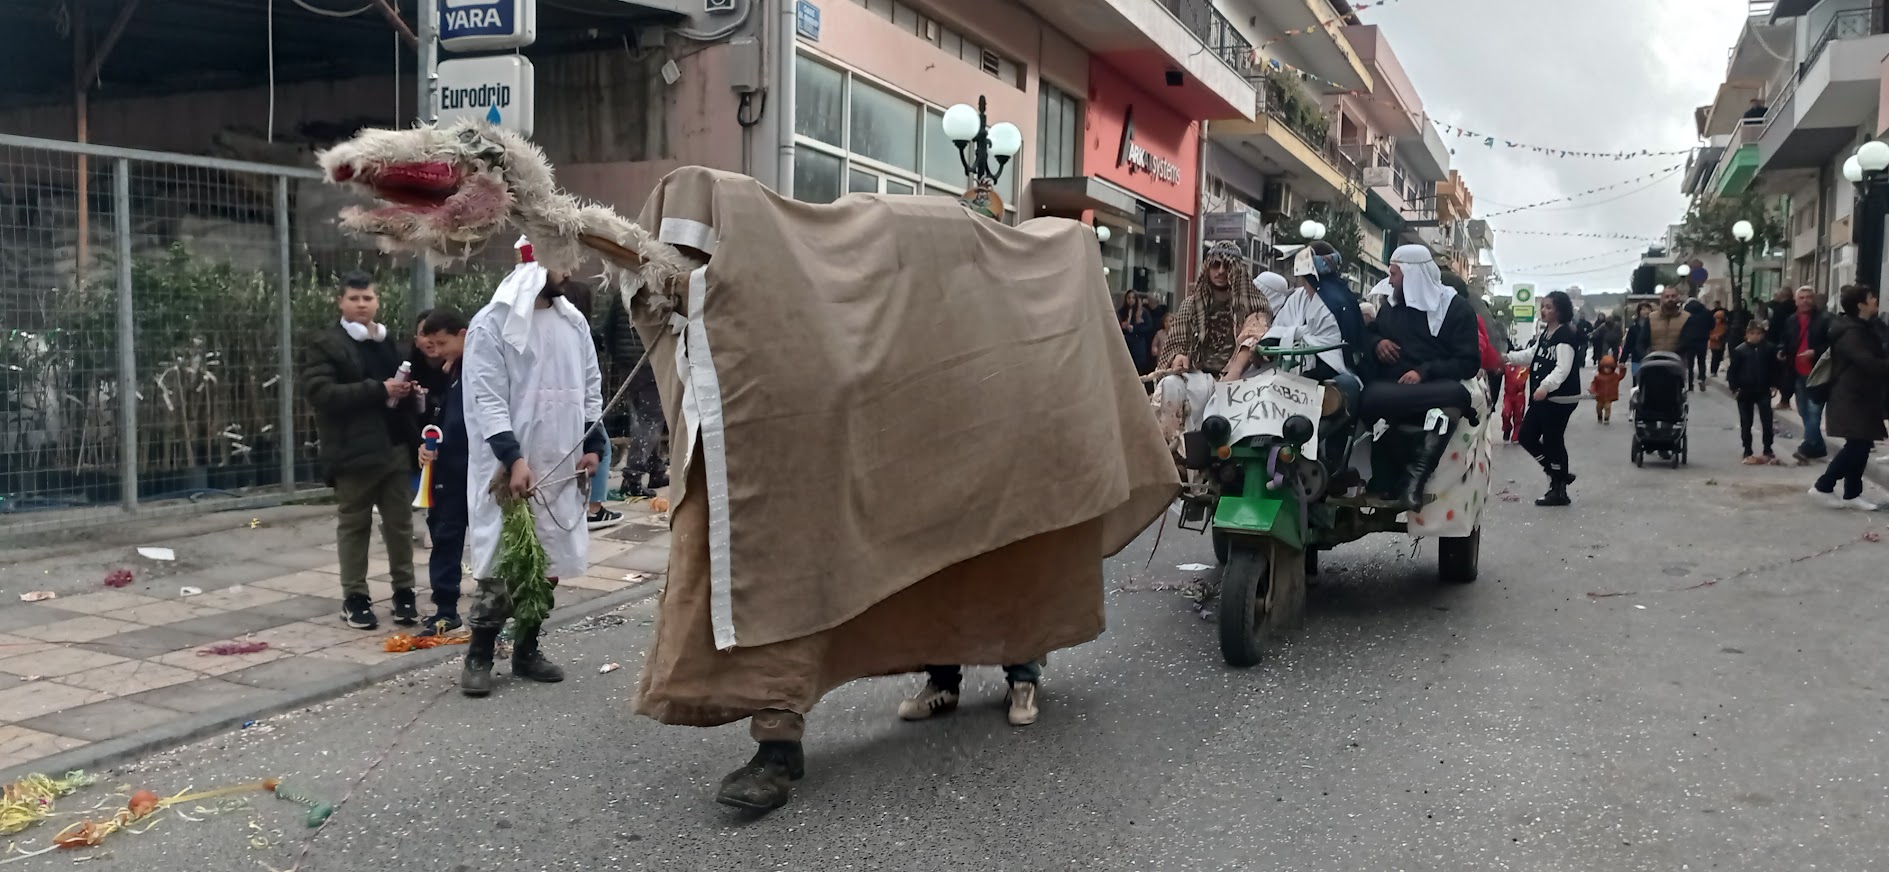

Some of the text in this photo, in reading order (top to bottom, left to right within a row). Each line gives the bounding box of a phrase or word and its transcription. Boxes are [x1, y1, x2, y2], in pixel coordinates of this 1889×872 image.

[445, 8, 502, 31] YARA
[441, 83, 510, 110] Eurodrip
[1152, 155, 1180, 185] systems
